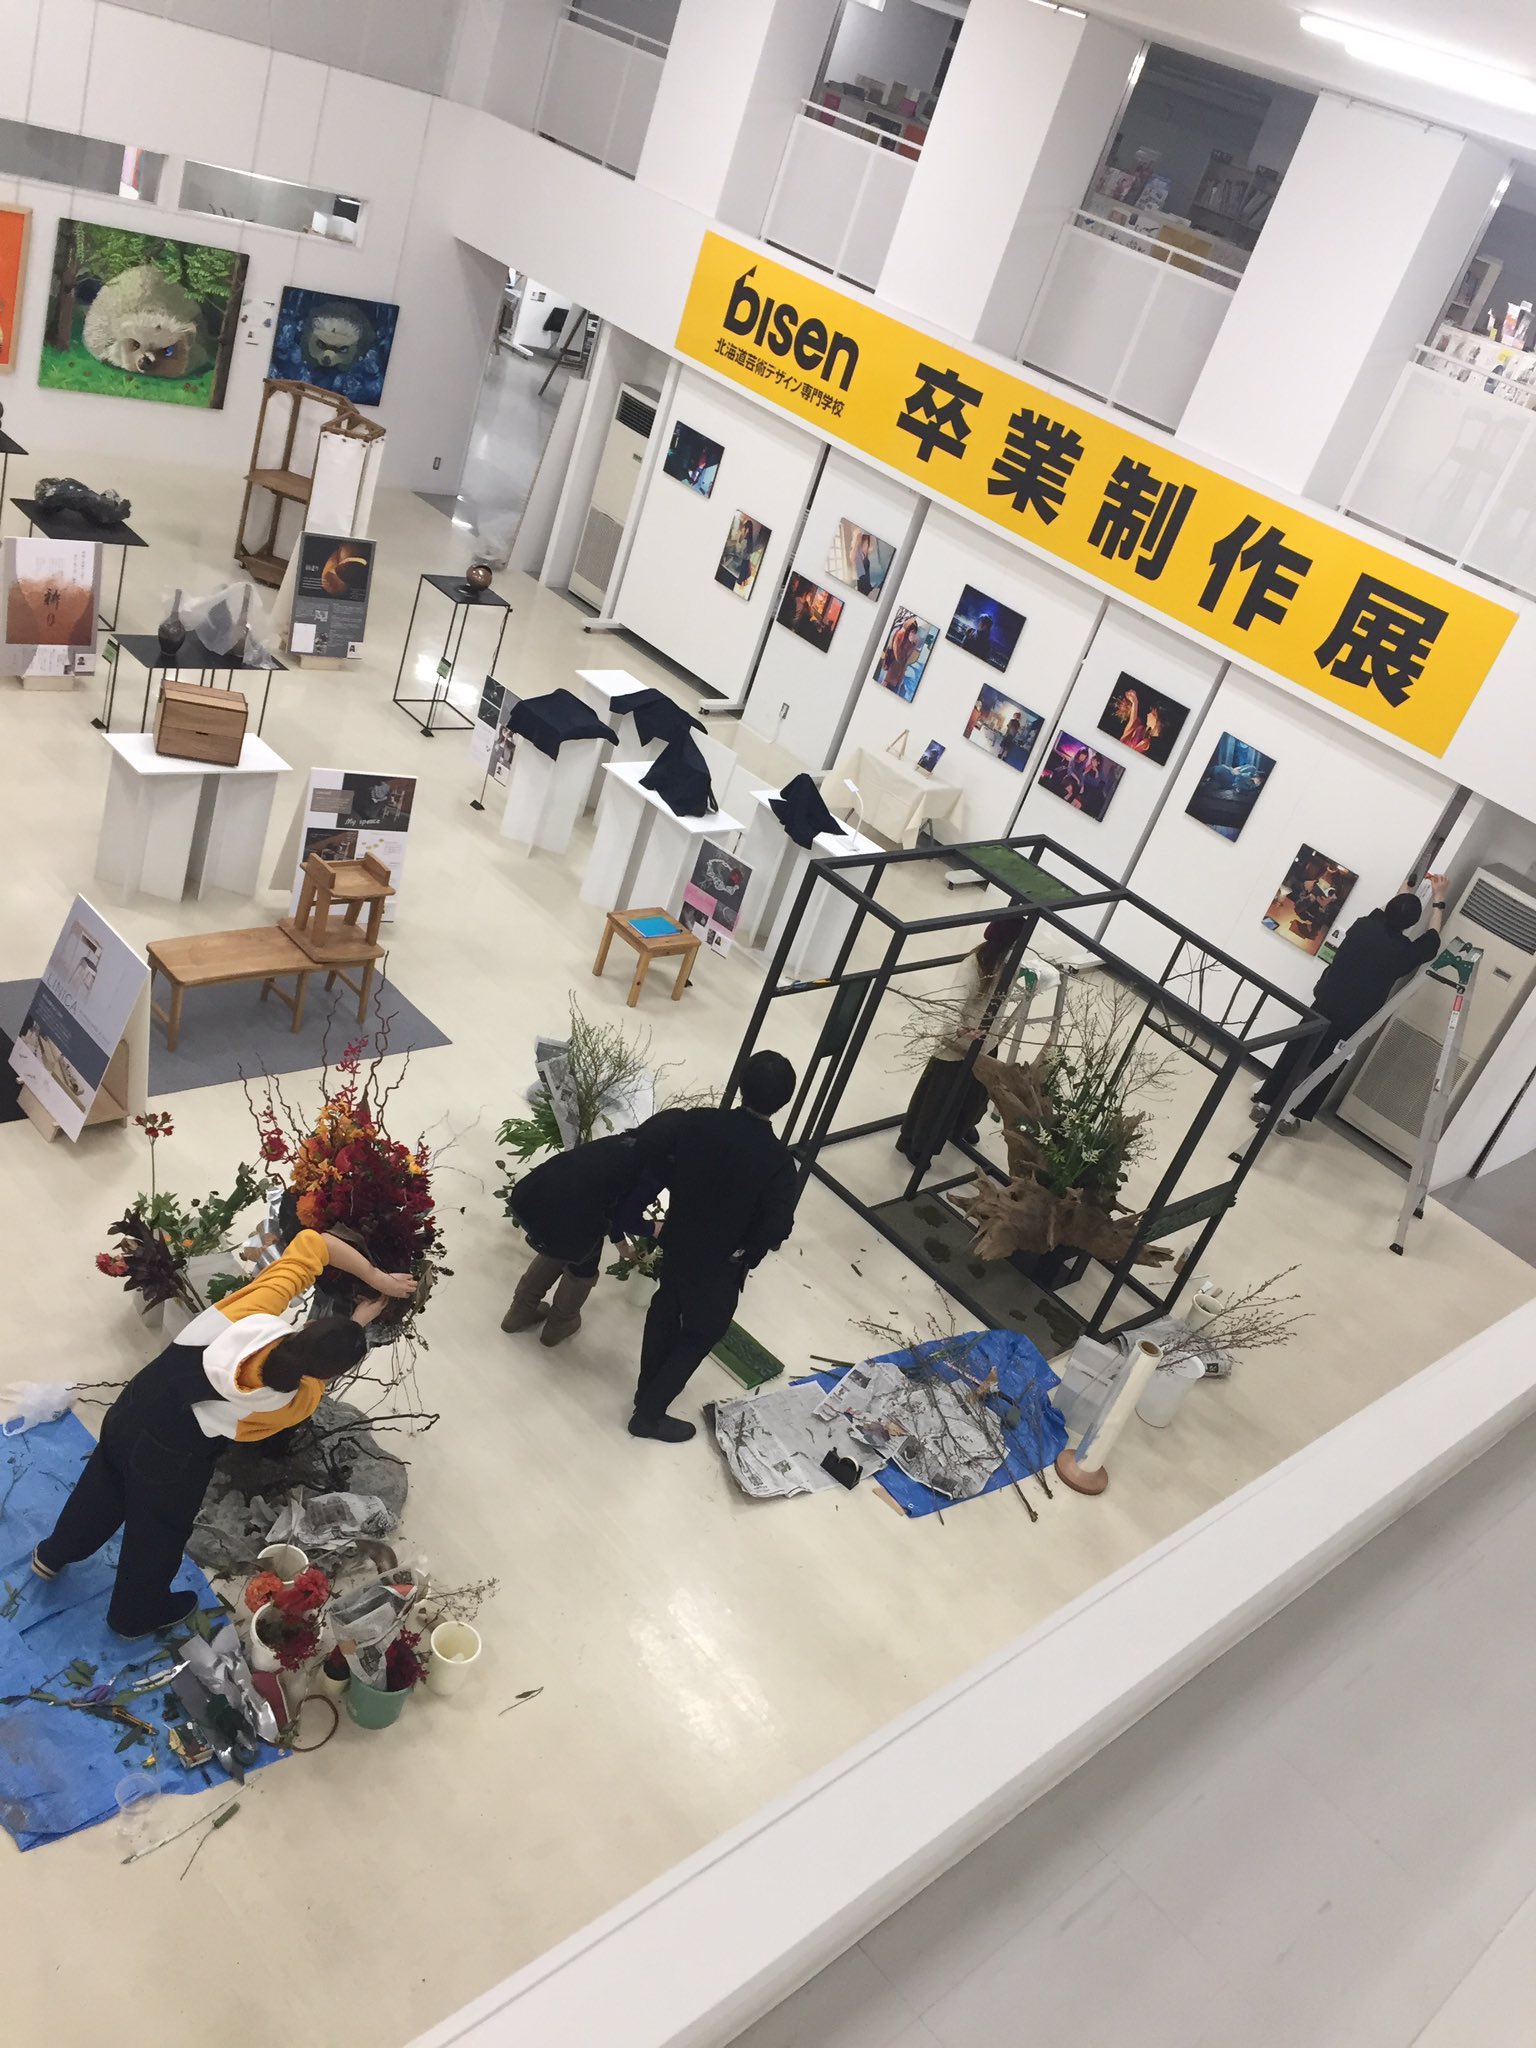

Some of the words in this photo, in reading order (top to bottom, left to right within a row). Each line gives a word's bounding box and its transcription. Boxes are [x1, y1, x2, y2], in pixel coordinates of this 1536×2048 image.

[714, 337, 846, 418] 北海道芸術デザイン専門学校
[723, 266, 860, 392] bisen
[895, 362, 1450, 708] 卒業制作展
